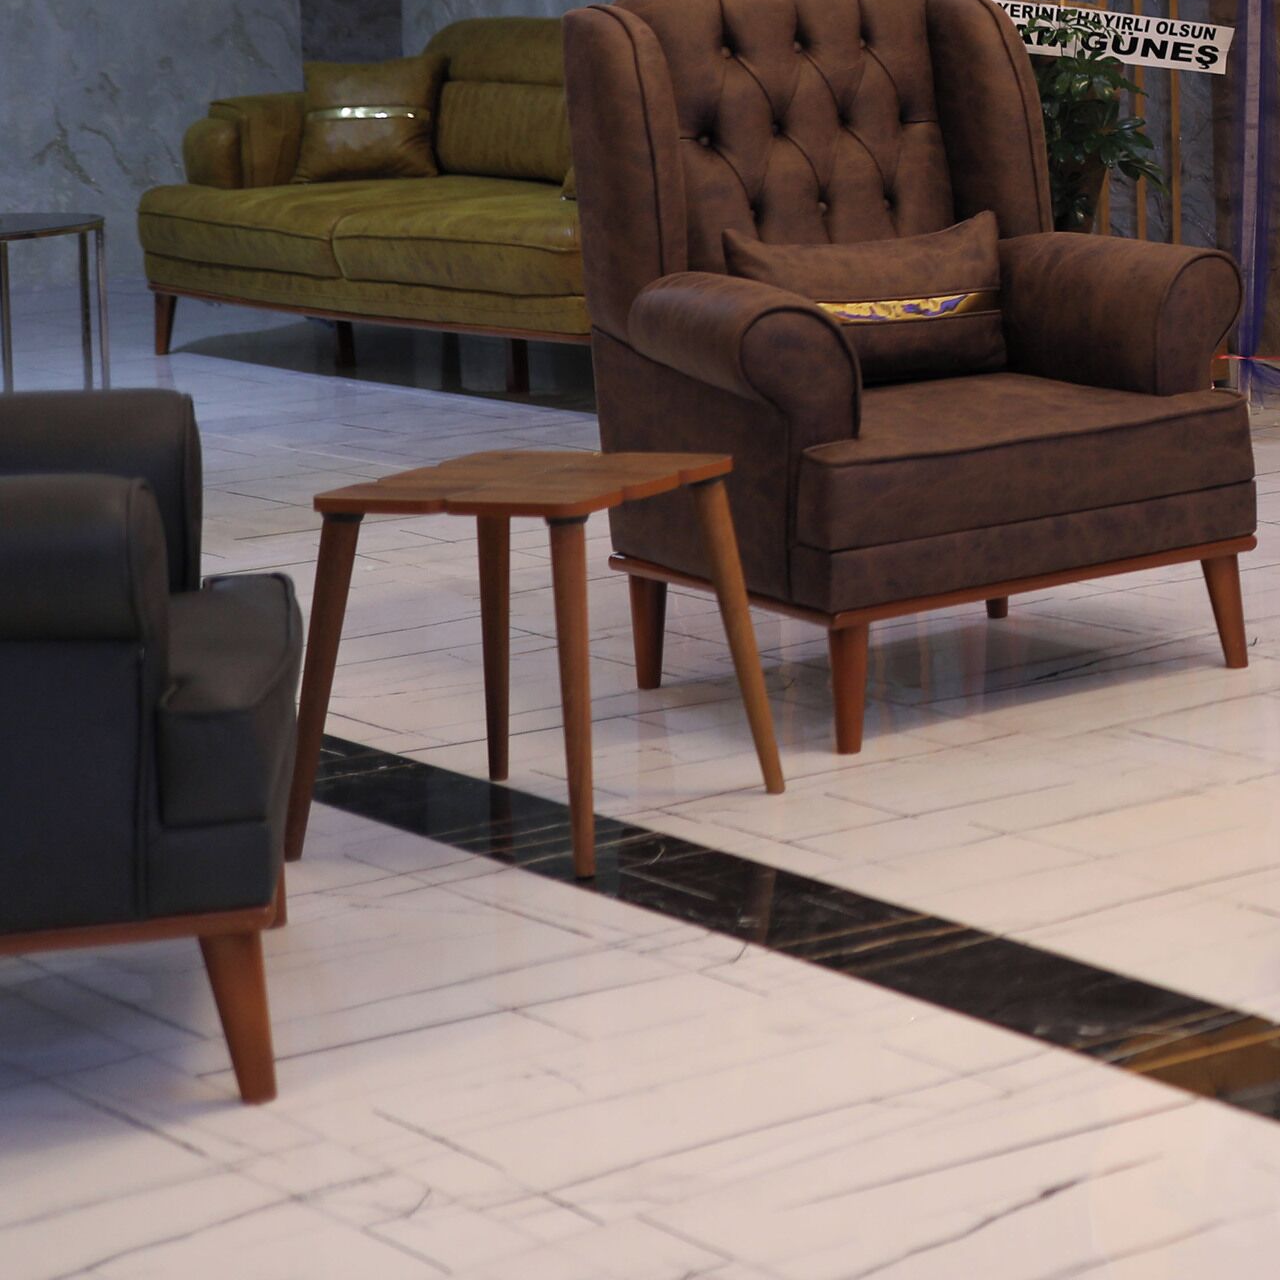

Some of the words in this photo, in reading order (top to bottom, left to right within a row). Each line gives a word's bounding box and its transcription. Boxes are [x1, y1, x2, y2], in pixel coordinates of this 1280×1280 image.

[1076, 10, 1151, 33] HAYIRLI
[1156, 20, 1217, 41] OLSUN
[1081, 31, 1219, 70] GÜNEŞ
